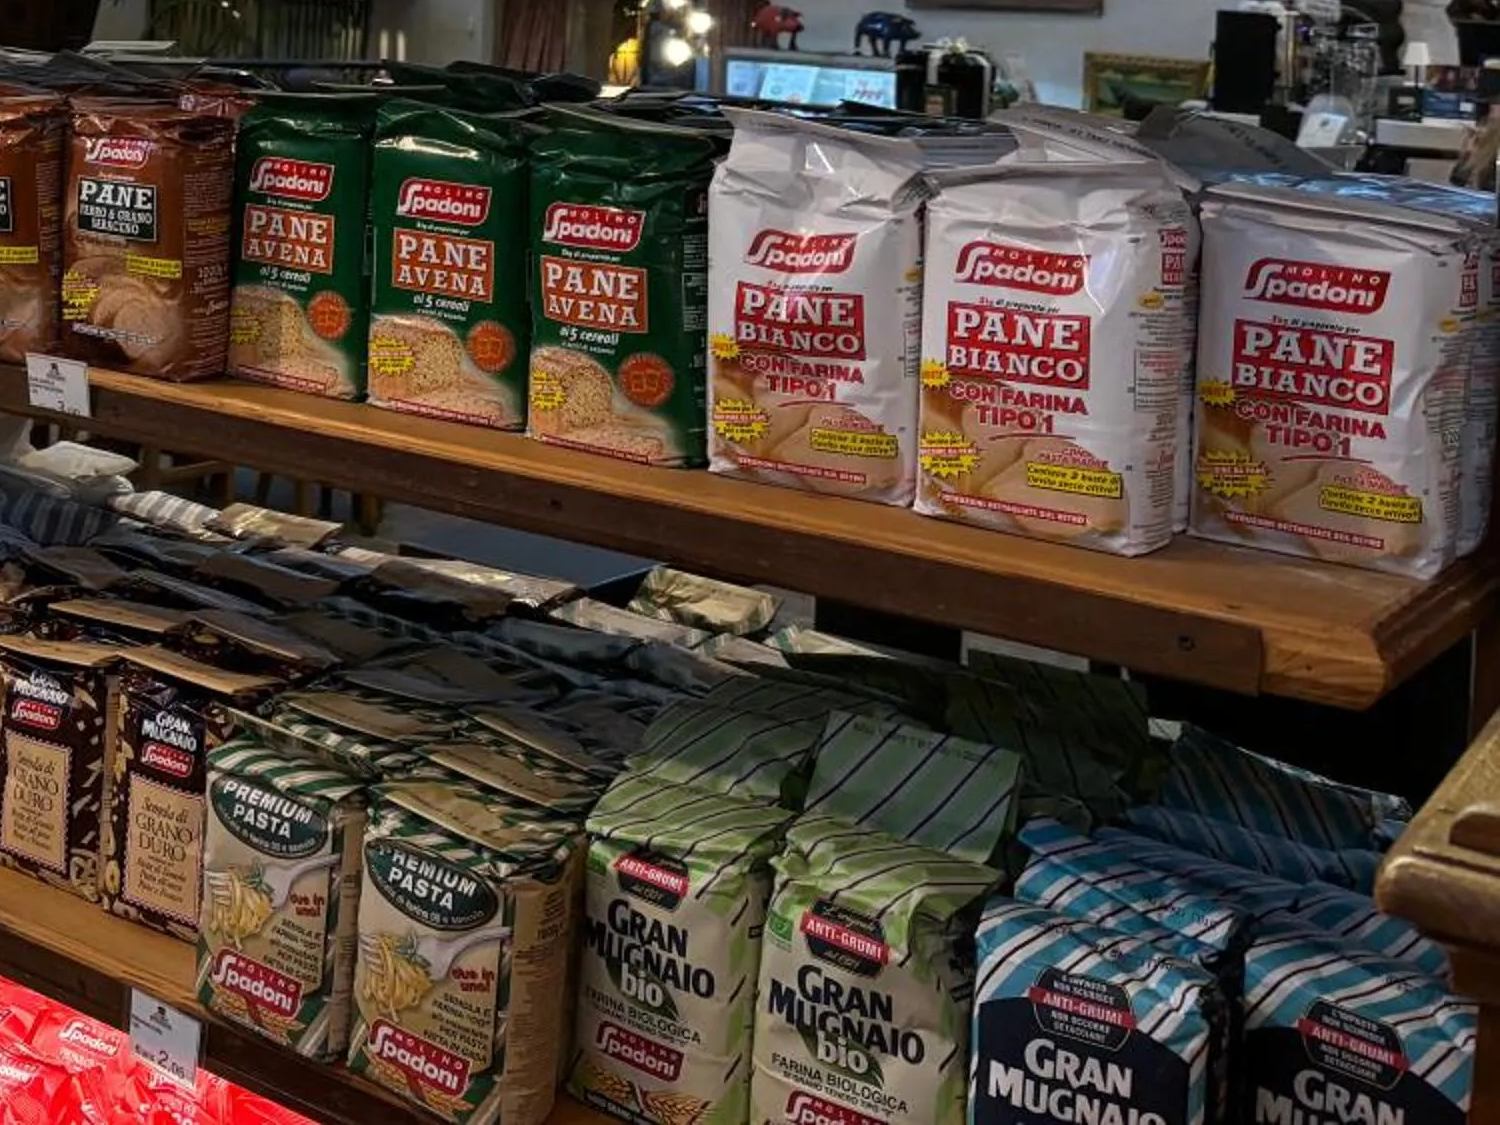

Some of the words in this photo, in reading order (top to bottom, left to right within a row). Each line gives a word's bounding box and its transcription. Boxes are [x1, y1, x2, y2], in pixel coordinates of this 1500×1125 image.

[80, 180, 153, 210] PANE
[249, 161, 324, 195] Spadoni
[117, 210, 153, 225] GRANO
[396, 183, 481, 218] Spadoni
[252, 210, 327, 243] PANE
[542, 208, 632, 244] Spadoni
[247, 238, 327, 267] AVENA
[400, 234, 487, 271] PANE
[750, 234, 845, 266] Spadoni
[954, 246, 1077, 290] Spadoni
[993, 249, 1083, 268] MOLINO
[398, 264, 486, 296] AVENA
[546, 262, 639, 300] PANE
[1244, 263, 1375, 307] Spadoni
[1284, 266, 1381, 286] MOLINO
[425, 296, 433, 309] 5
[435, 297, 470, 312] cereali
[549, 296, 639, 326] AVENA
[741, 288, 855, 327] PANE
[570, 328, 578, 341] 5
[580, 331, 619, 346] cereali
[738, 322, 860, 353] BIANCO
[954, 307, 1082, 351] PANE
[950, 344, 1084, 382] BIANCO
[1242, 325, 1384, 376] PANE
[741, 355, 790, 374] CON
[791, 361, 865, 384] FARINA
[766, 375, 823, 397] TIPO
[1235, 362, 1384, 407] BIANCO
[950, 380, 997, 403] CON
[1000, 388, 1089, 416] FARINA
[976, 406, 1037, 430] TIPO
[1043, 414, 1053, 434] 1
[1237, 400, 1288, 424] CON
[1297, 410, 1387, 439] FARINA
[1266, 425, 1333, 452] TIPO
[1340, 436, 1351, 456] 1
[156, 710, 193, 735] GRAN
[223, 778, 314, 824] PREMIUM
[136, 812, 194, 845] GRANO
[233, 803, 292, 840] PASTA
[139, 832, 187, 862] DURO
[378, 841, 478, 899] PREMIUM
[619, 857, 685, 892] ANTI-GRUMI
[388, 868, 455, 911] PASTA
[607, 899, 688, 958] GRAN
[805, 918, 884, 960] ANTI-GRUMI
[480, 969, 494, 981] in
[583, 922, 716, 1000] MUGNAIO
[213, 954, 293, 1013] Spadoni
[619, 963, 664, 1008] bio
[797, 964, 894, 1022] GRAN
[628, 1003, 700, 1046] BIOLOGICA
[768, 978, 925, 1065] MUGNAIO
[1043, 992, 1124, 1025] ANTI-GRUMI
[369, 1026, 459, 1090] Spadoni
[598, 1025, 676, 1079] Spadoni
[817, 1029, 868, 1074] bio
[1311, 1026, 1395, 1065] ANTI-GRUMI
[771, 1052, 823, 1083] FARINA
[827, 1072, 909, 1114] BIOLOGICA
[1022, 1038, 1133, 1099] GRAN
[1293, 1069, 1405, 1125] GRAN
